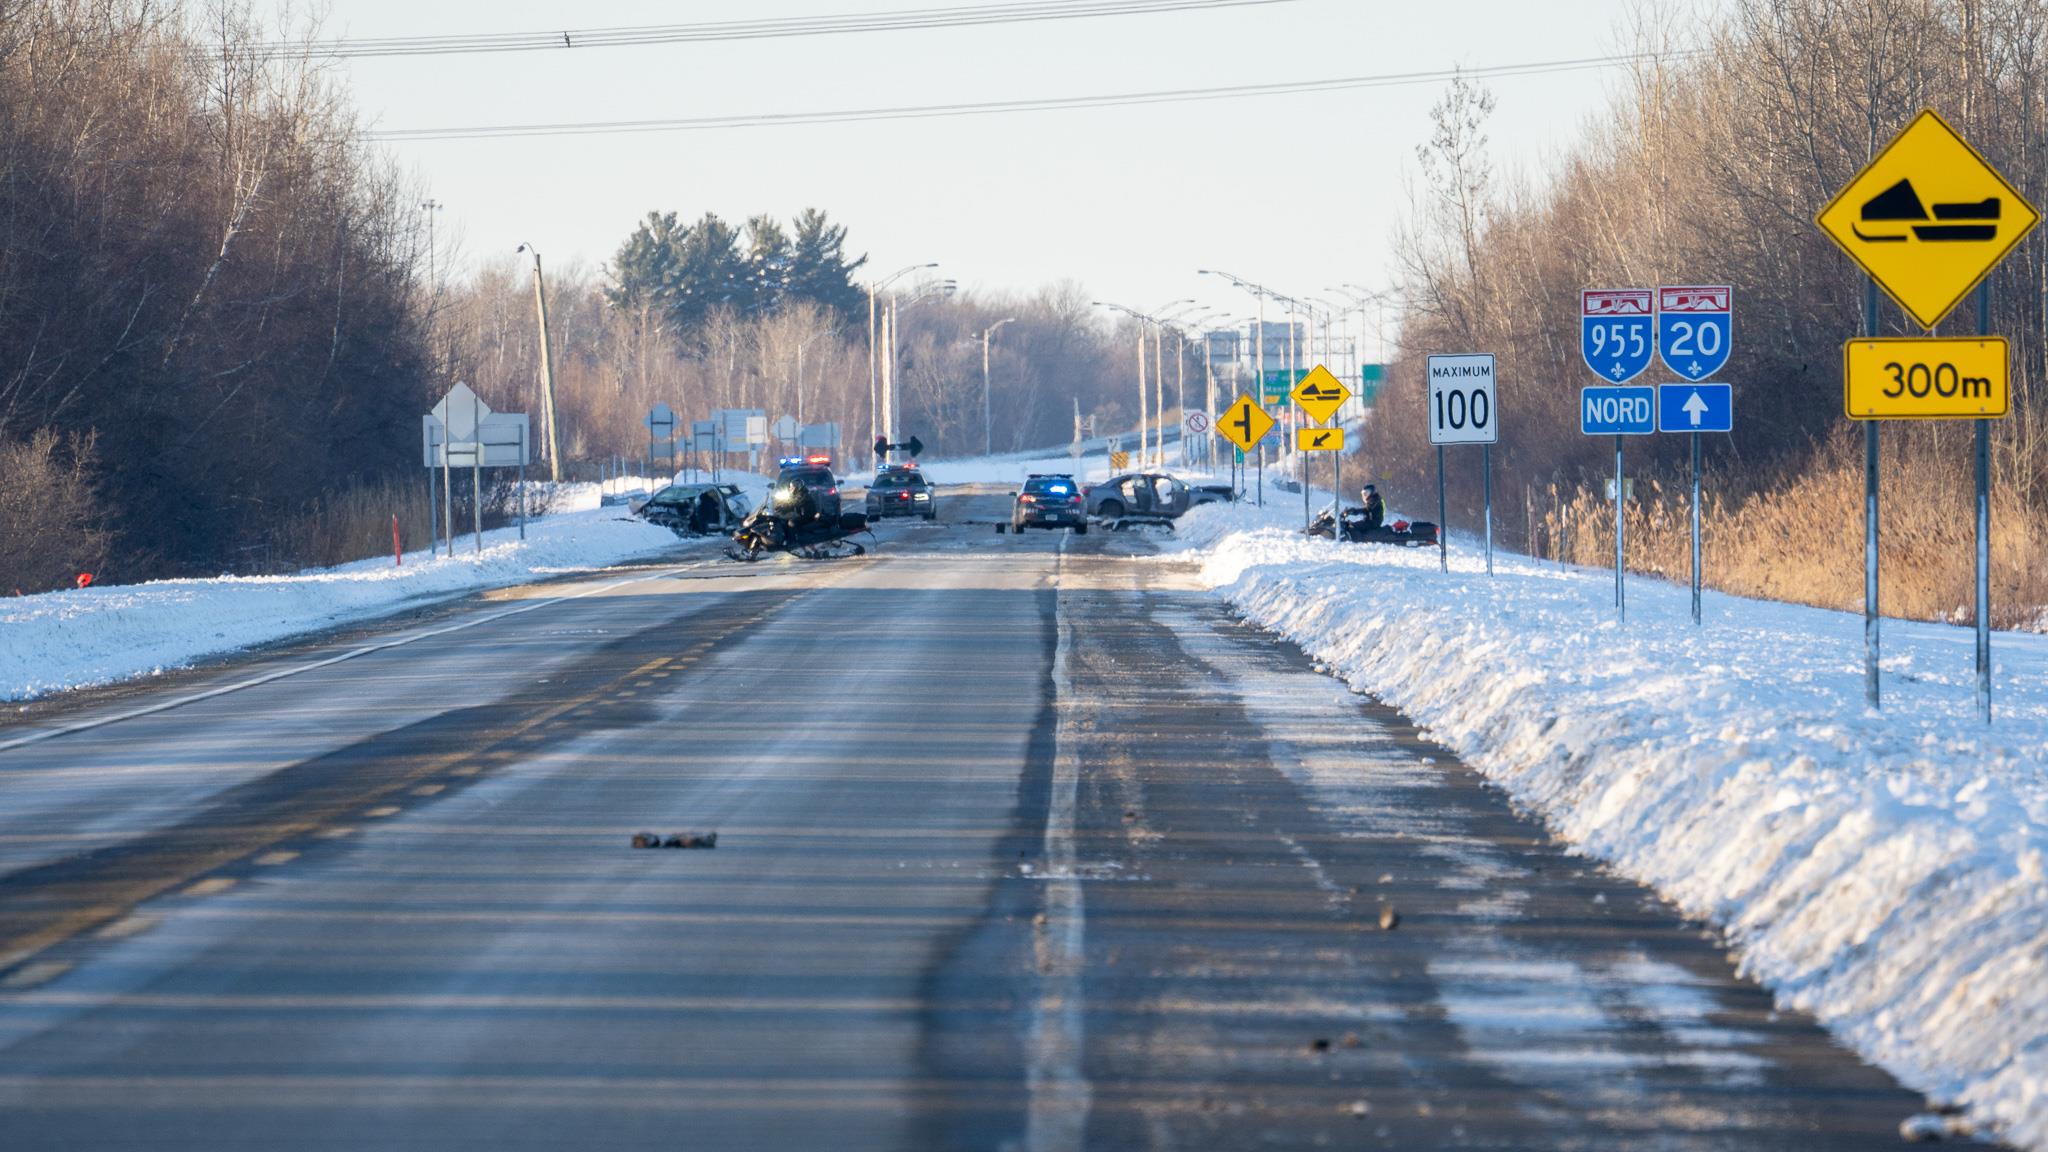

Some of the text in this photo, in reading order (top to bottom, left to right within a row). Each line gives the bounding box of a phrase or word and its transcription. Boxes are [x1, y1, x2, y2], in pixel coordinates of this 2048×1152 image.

[1591, 324, 1645, 358] 955
[1669, 321, 1721, 357] 20
[1432, 365, 1490, 378] MAXIMUM
[1882, 362, 1991, 398] 300m
[1435, 389, 1489, 430] 100
[1586, 397, 1650, 424] NORD
